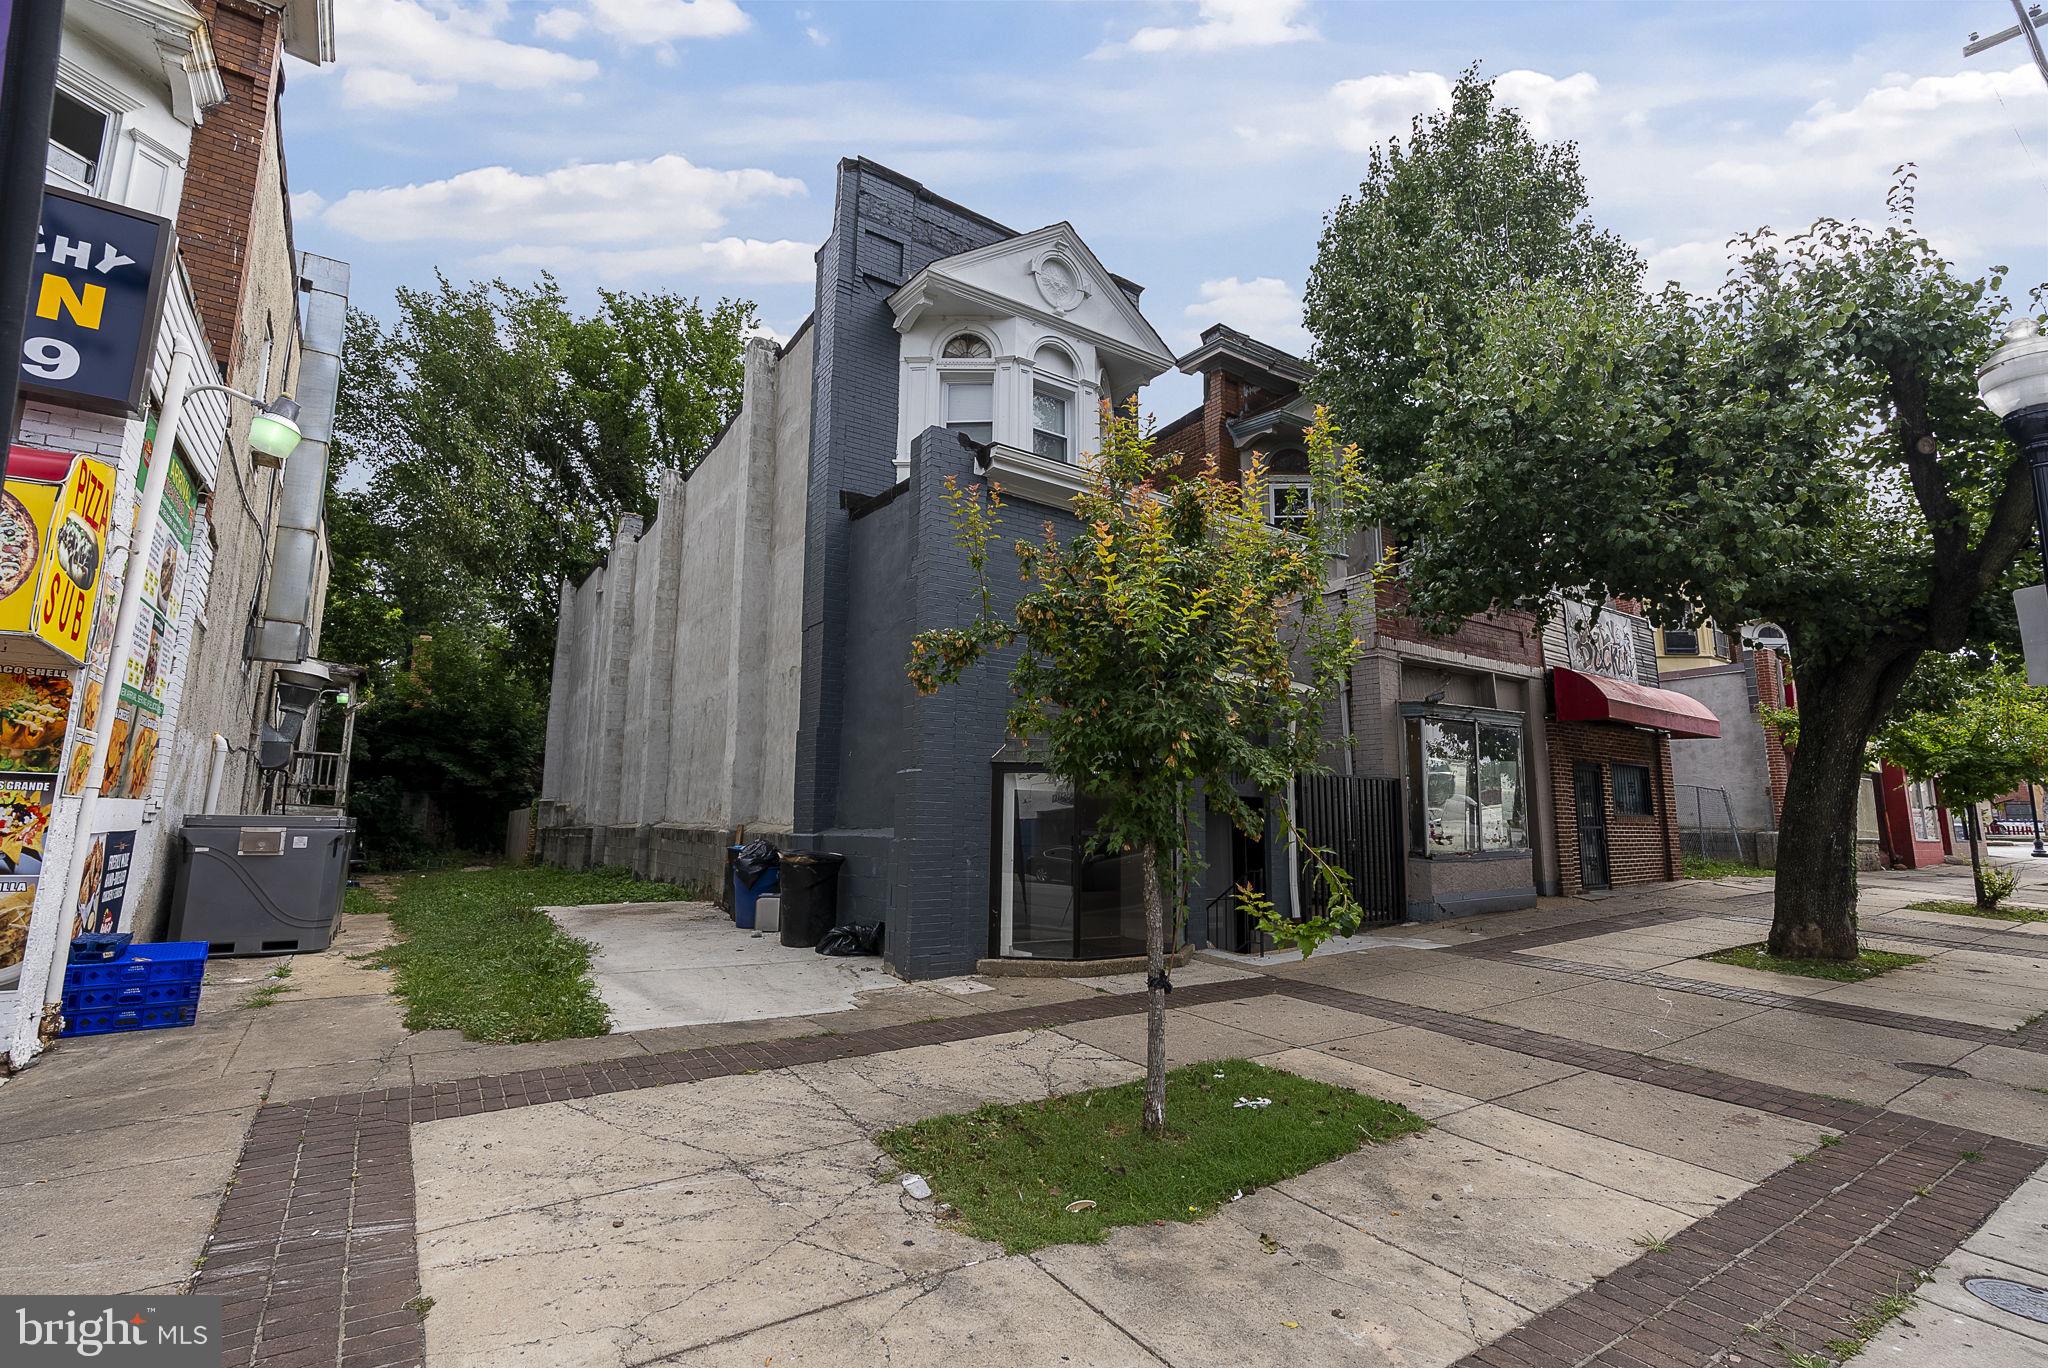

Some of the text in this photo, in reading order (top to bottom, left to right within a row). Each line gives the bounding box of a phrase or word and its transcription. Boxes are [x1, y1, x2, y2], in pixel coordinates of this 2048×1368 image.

[36, 273, 106, 330] N
[21, 336, 81, 380] 9
[74, 459, 110, 538] PIZZA
[43, 572, 85, 642] SUB
[0, 664, 69, 678] CO SHELL
[6, 780, 51, 792] GRANDE
